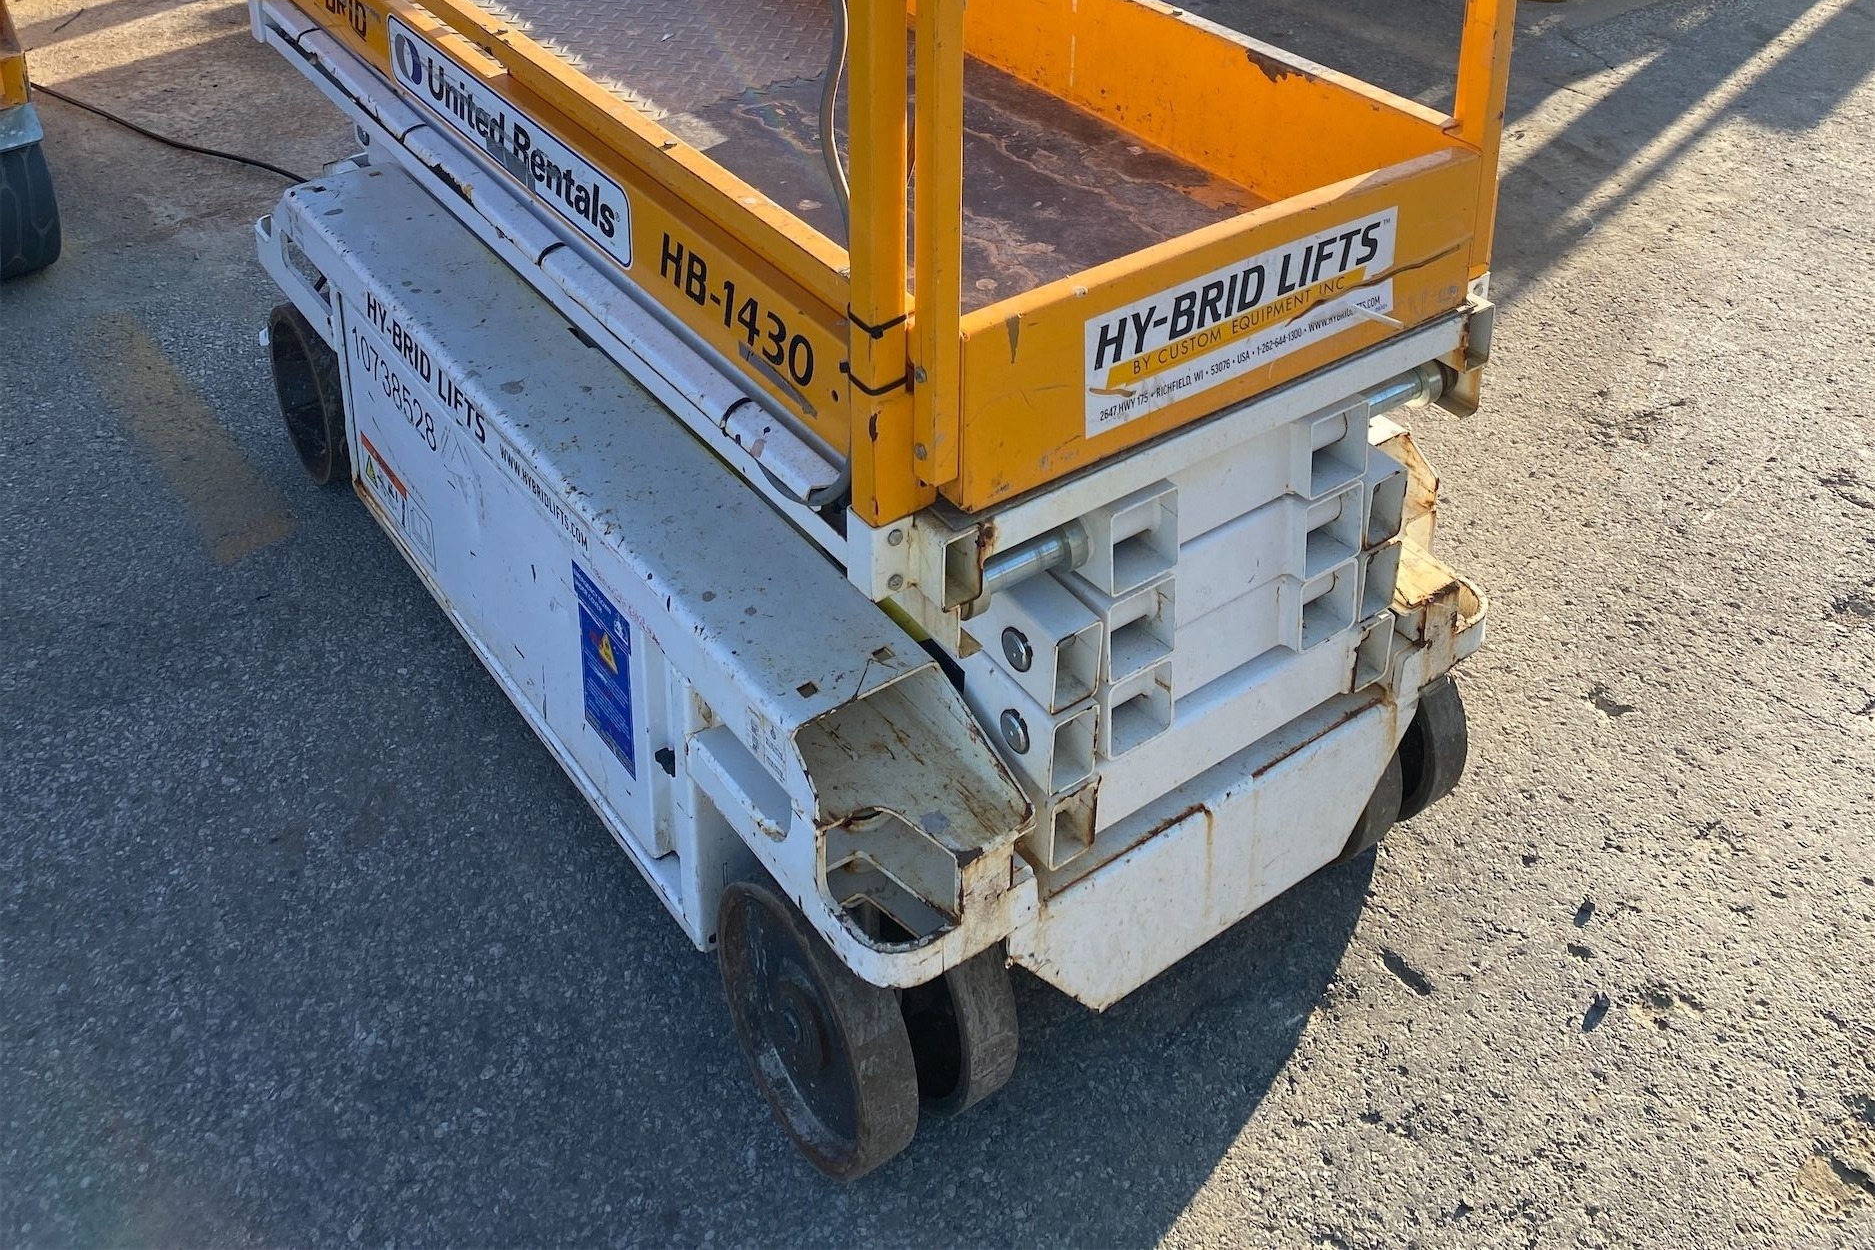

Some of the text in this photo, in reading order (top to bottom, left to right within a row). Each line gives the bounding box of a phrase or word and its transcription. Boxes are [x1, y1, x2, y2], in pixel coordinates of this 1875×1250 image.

[427, 57, 616, 239] United Rentals
[660, 231, 815, 387] HB-1430
[1094, 221, 1381, 371] HY-BRID LIFTS
[1133, 275, 1346, 375] BY CUSTOM EQUIPMENT INC
[351, 325, 437, 452] 10738528
[366, 290, 486, 445] HY-BRID LIFTS
[1100, 404, 1117, 422] 2647
[1118, 398, 1136, 414] HWY
[1137, 392, 1149, 406] 175
[1194, 370, 1204, 382] WI
[1210, 358, 1231, 376] 53076
[1237, 350, 1250, 364] USA
[500, 442, 588, 552] WWW.HYBRIDLIFTS.COM
